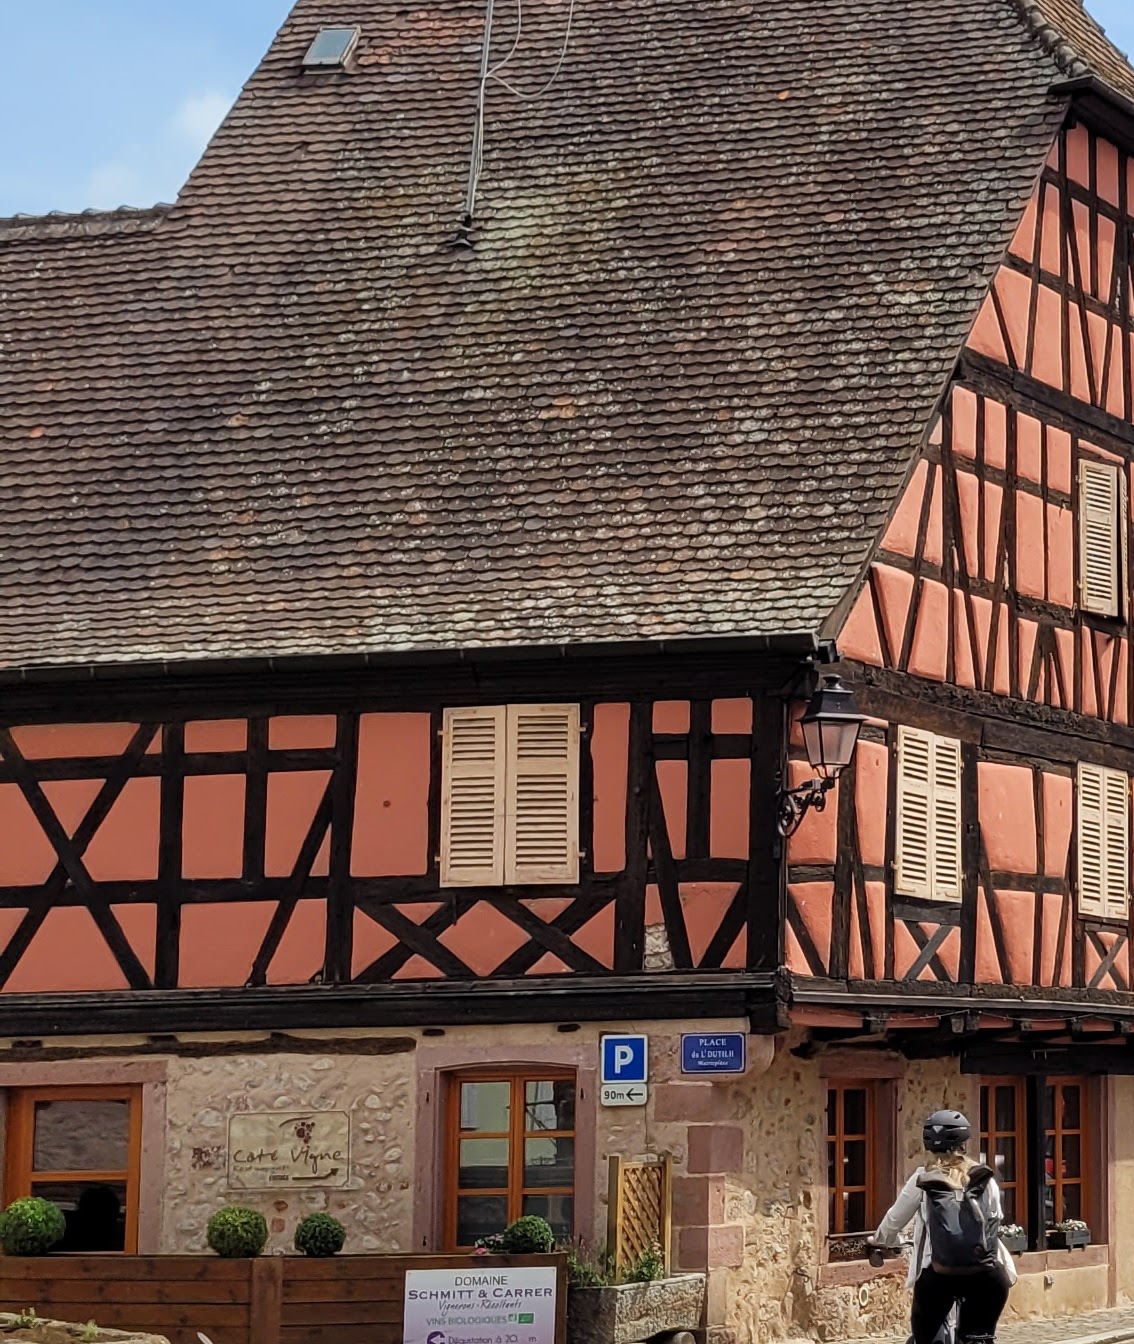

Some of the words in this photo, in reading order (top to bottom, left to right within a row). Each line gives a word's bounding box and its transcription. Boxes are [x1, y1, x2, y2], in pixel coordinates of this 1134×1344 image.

[699, 1038, 727, 1046] PLACE
[614, 1045, 634, 1074] P
[604, 1090, 625, 1100] 90m
[291, 1145, 343, 1174] Vigne
[455, 1276, 508, 1286] DOMAINE
[408, 1289, 474, 1300] SCHMITT
[477, 1289, 488, 1298] &
[492, 1287, 553, 1298] CARRER
[426, 1316, 446, 1327] VINS
